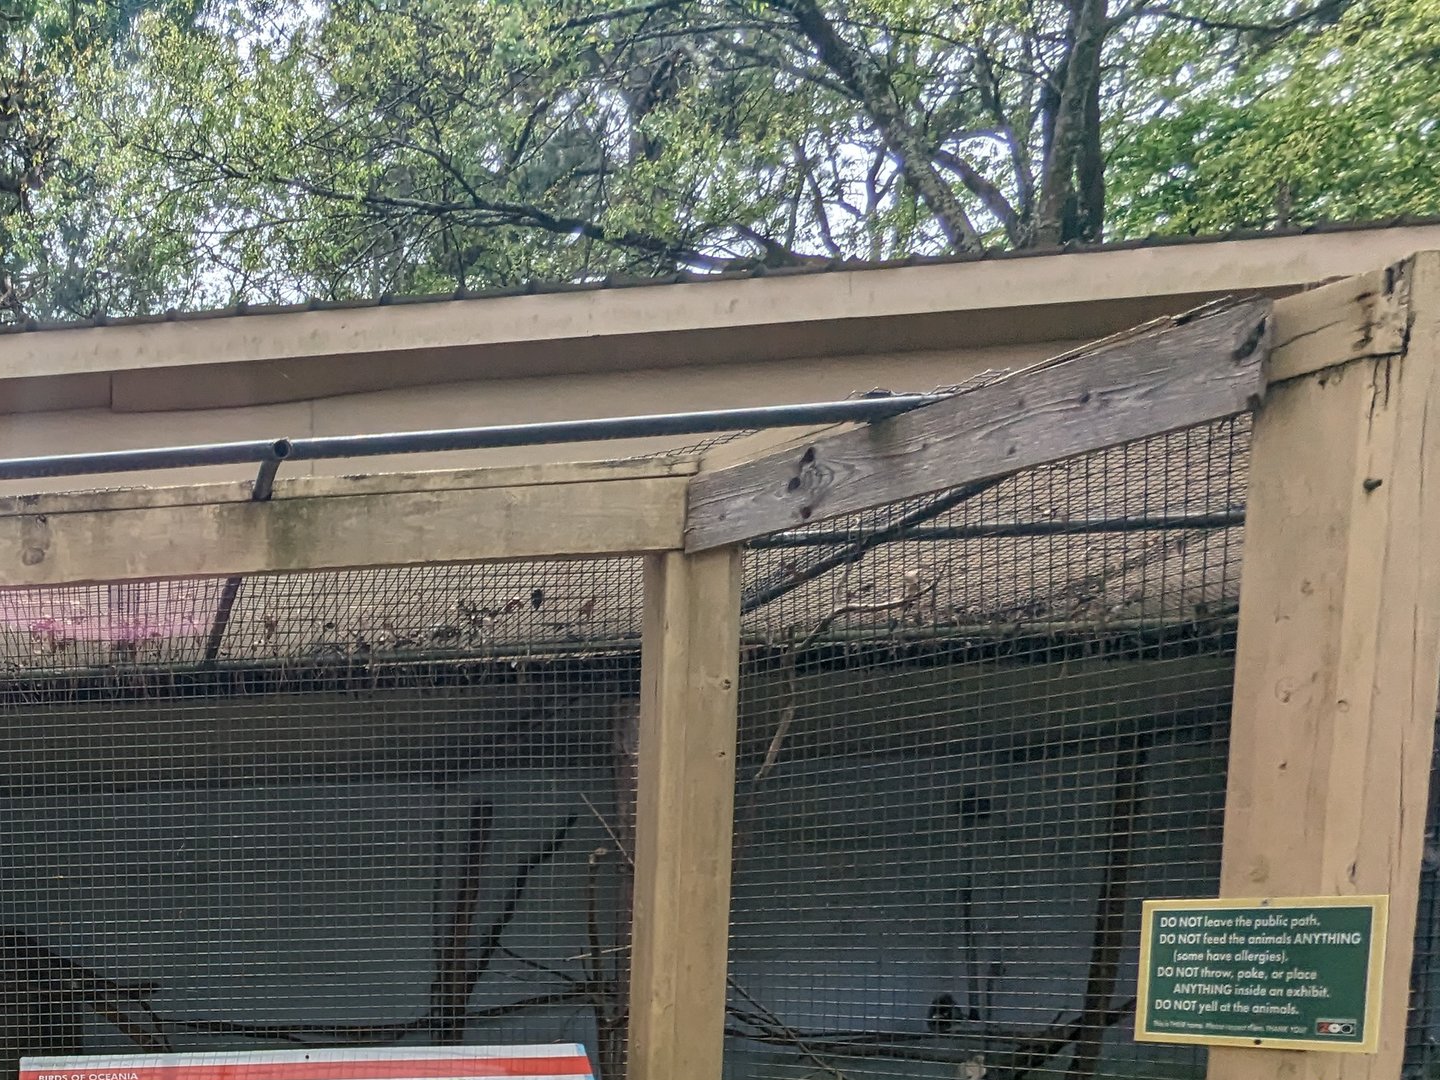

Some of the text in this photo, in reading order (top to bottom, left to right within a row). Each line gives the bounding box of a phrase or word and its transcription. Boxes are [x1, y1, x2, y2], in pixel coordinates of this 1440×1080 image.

[1160, 913, 1320, 930] DO NOT leave the public path.
[1159, 932, 1361, 944] DO NOT feed the animals ANYTHING
[1173, 949, 1289, 964] (some have allergies).
[1157, 966, 1317, 982] DO NOT throw, poke, or place
[1173, 984, 1330, 998] ANYTHING inside an exhibit.
[1155, 999, 1300, 1015] DO NOT yell at the animals.
[1318, 1021, 1353, 1034] ZOO
